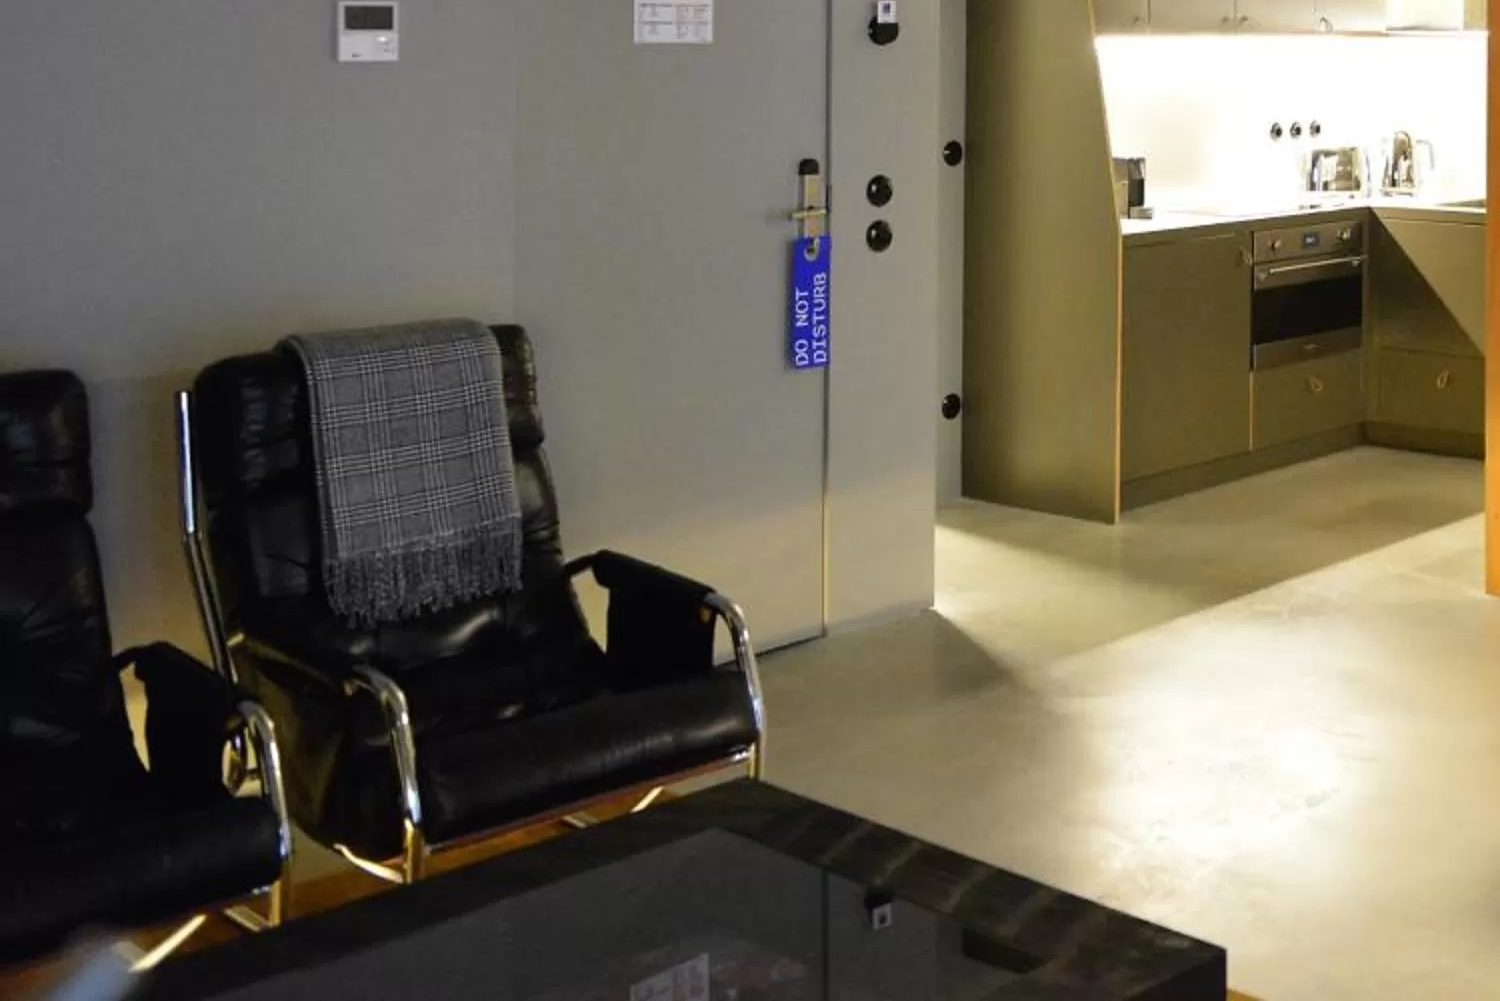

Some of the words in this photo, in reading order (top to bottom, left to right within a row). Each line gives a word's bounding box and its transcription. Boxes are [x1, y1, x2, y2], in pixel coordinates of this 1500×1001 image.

[795, 287, 809, 326] NOT
[812, 272, 827, 363] DISTURB
[794, 339, 809, 366] DO
